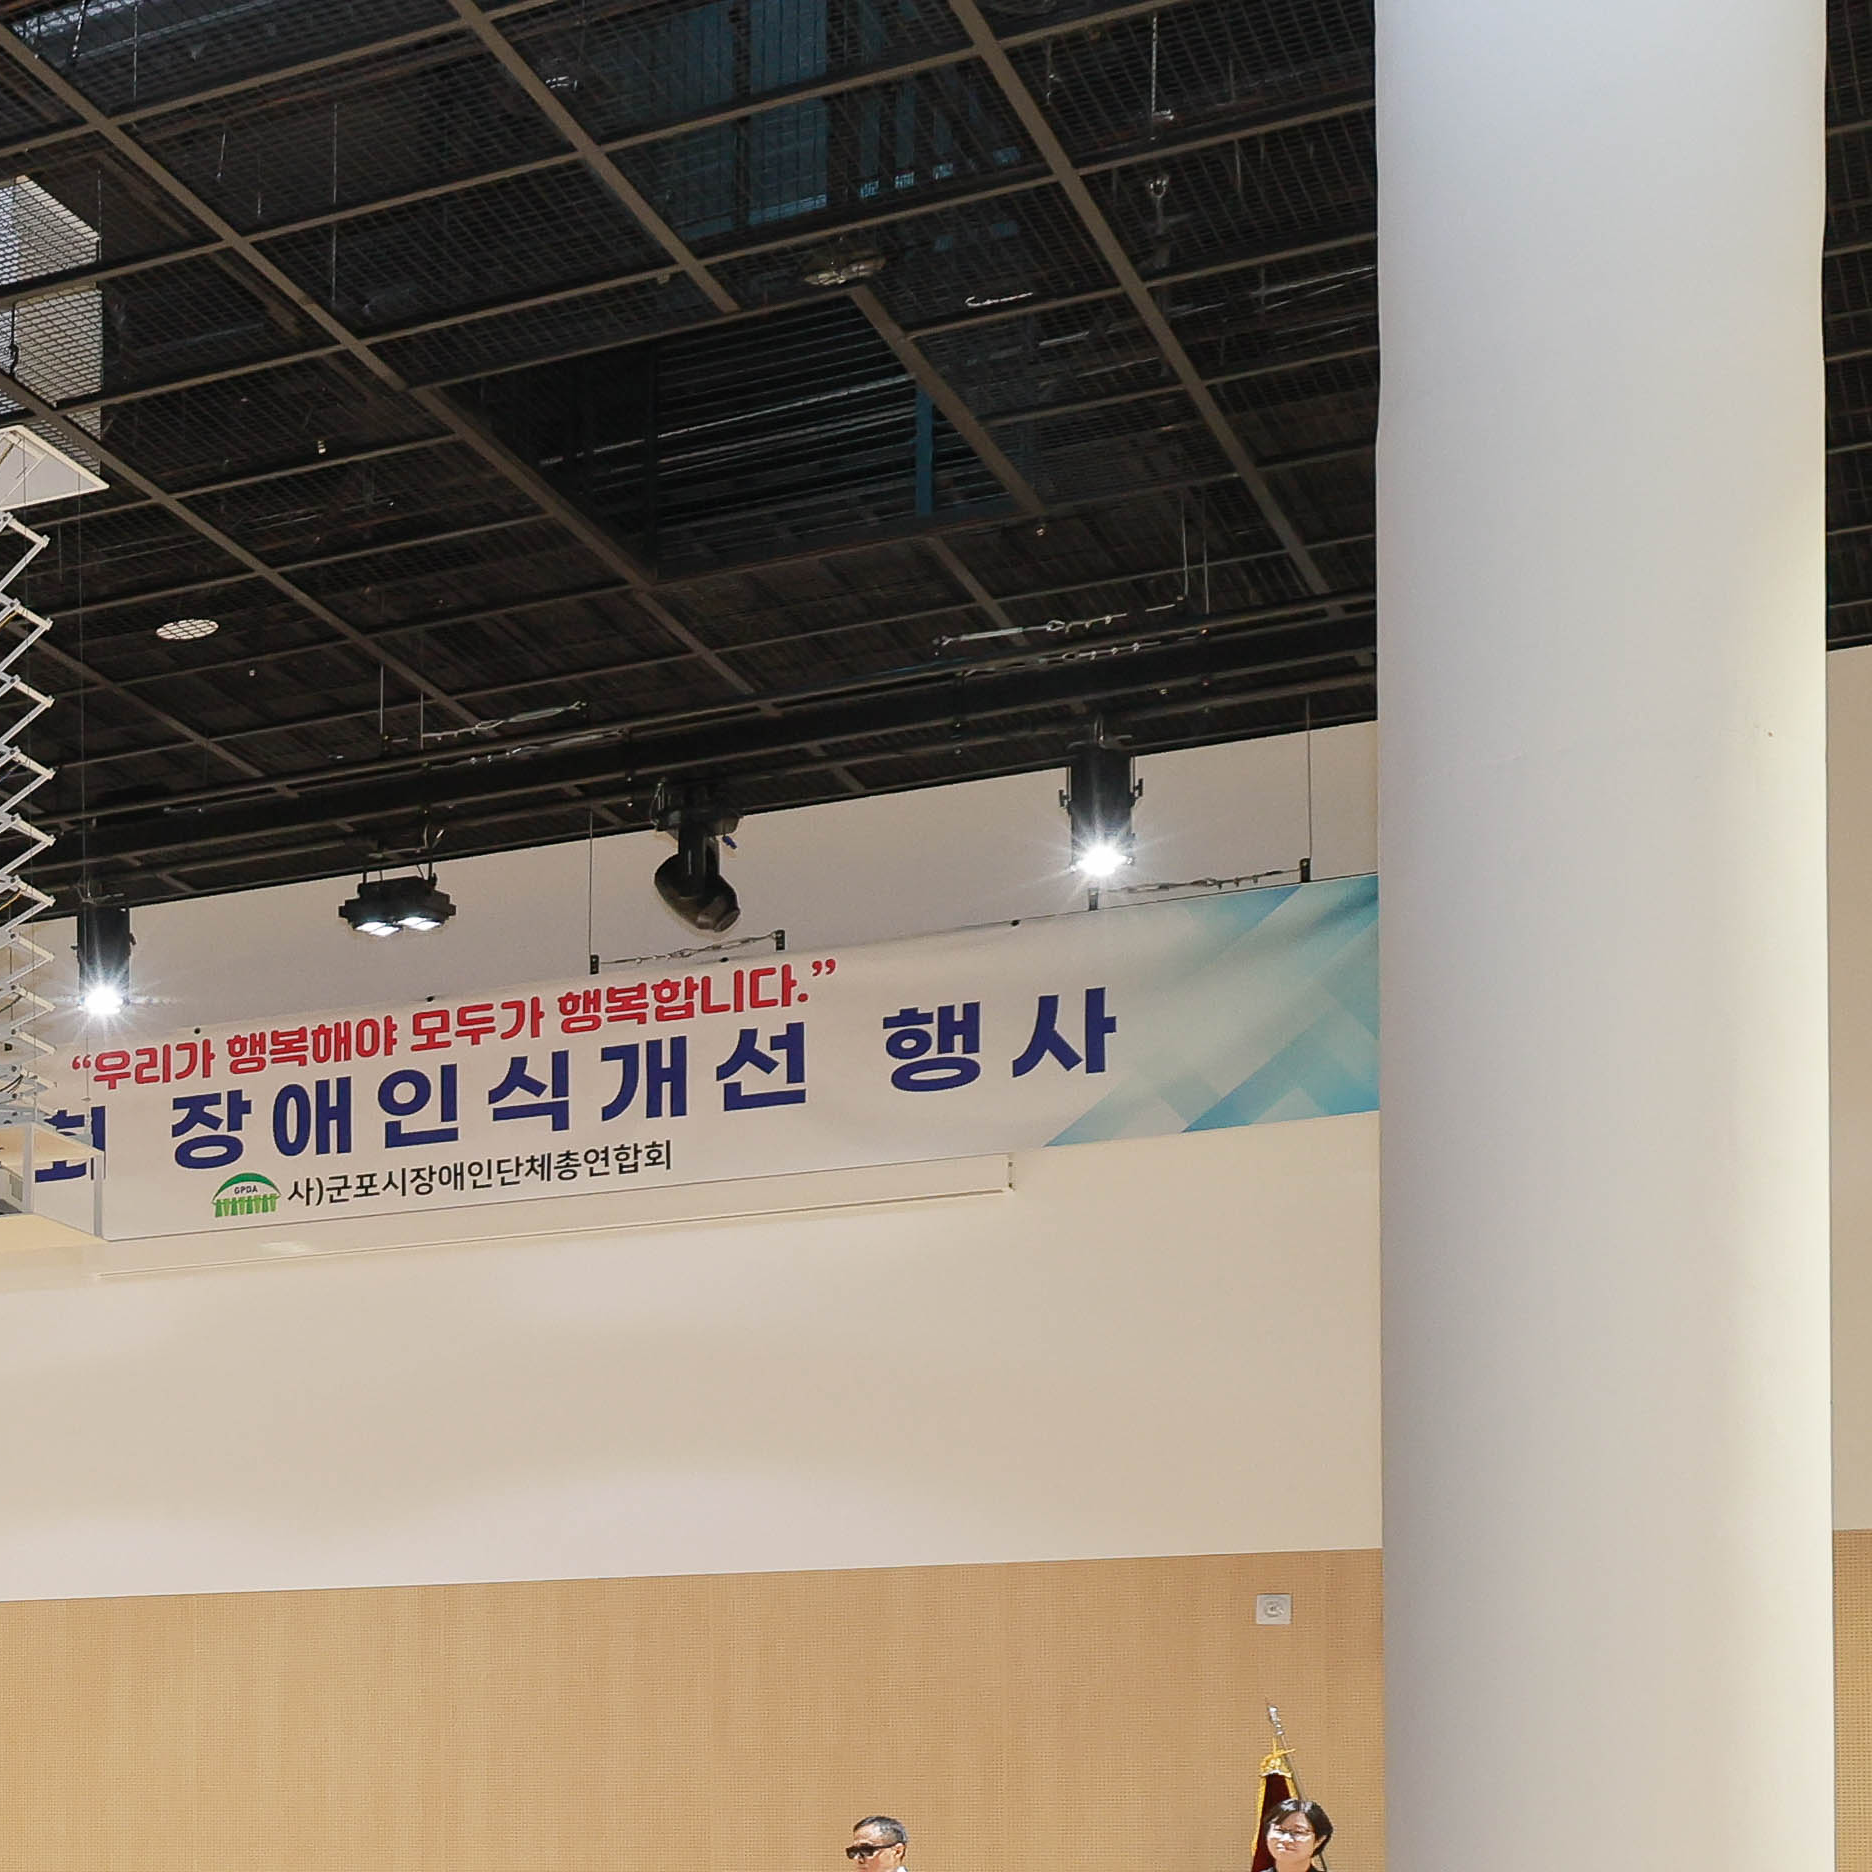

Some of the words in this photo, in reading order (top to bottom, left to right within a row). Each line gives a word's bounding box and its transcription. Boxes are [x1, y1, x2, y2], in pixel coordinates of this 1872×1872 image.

[71, 1039, 217, 1090] “우리가
[226, 1015, 398, 1076] 행복해야
[410, 995, 546, 1054] 모두가
[557, 958, 837, 1035] 행복합니다.”
[883, 986, 1118, 1093] 행사
[233, 1184, 258, 1195] GPDA
[287, 1139, 674, 1208] 사)군포시장애인단체총연합회
